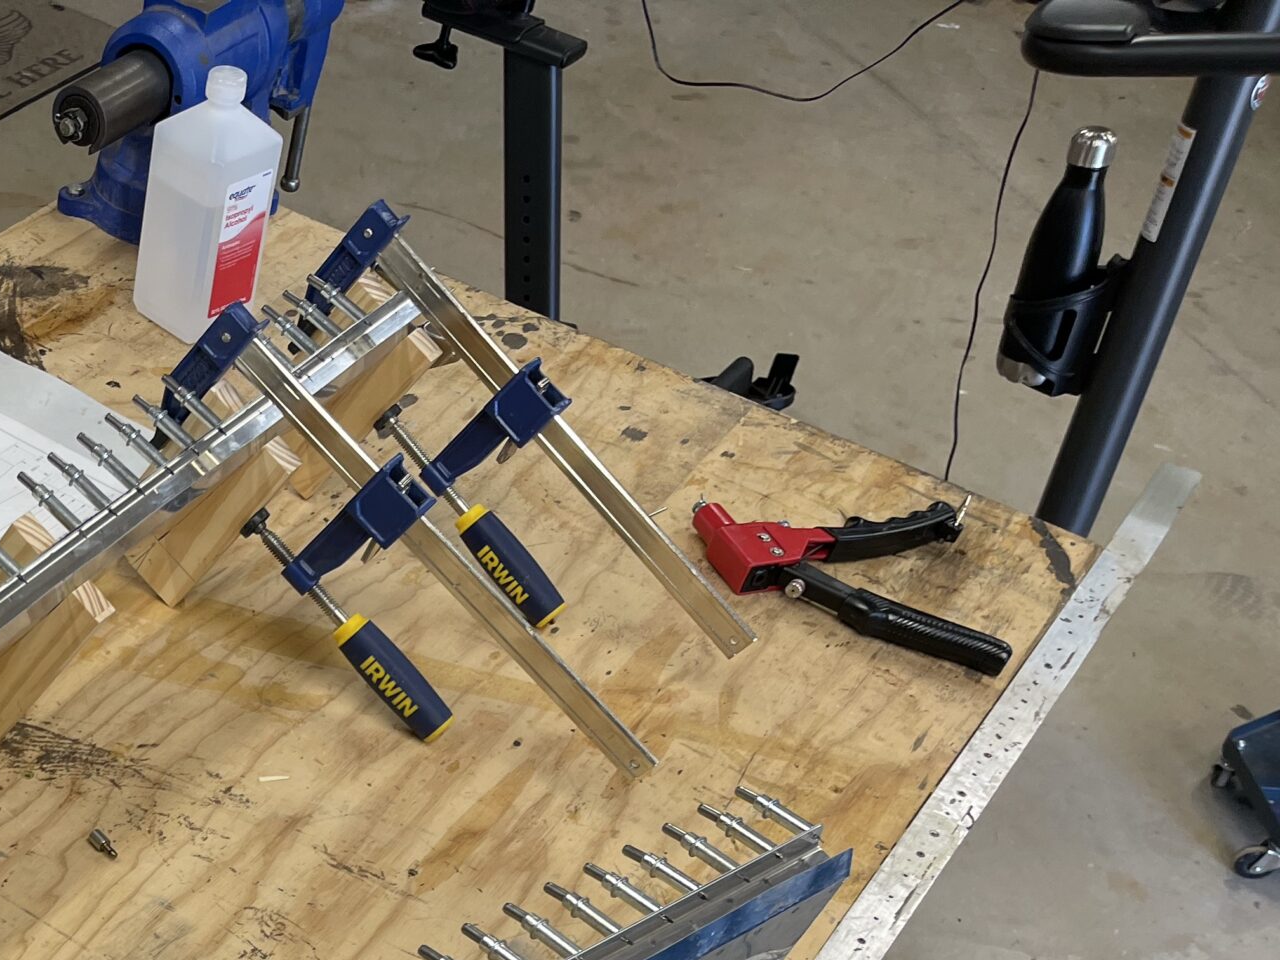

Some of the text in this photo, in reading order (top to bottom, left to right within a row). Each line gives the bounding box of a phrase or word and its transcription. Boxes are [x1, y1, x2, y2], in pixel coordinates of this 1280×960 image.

[6, 49, 85, 88] HERE
[223, 215, 248, 230] Alcohol
[225, 204, 254, 222] Isopropyl
[476, 544, 530, 605] IRWIN
[360, 655, 420, 719] IRWIN
